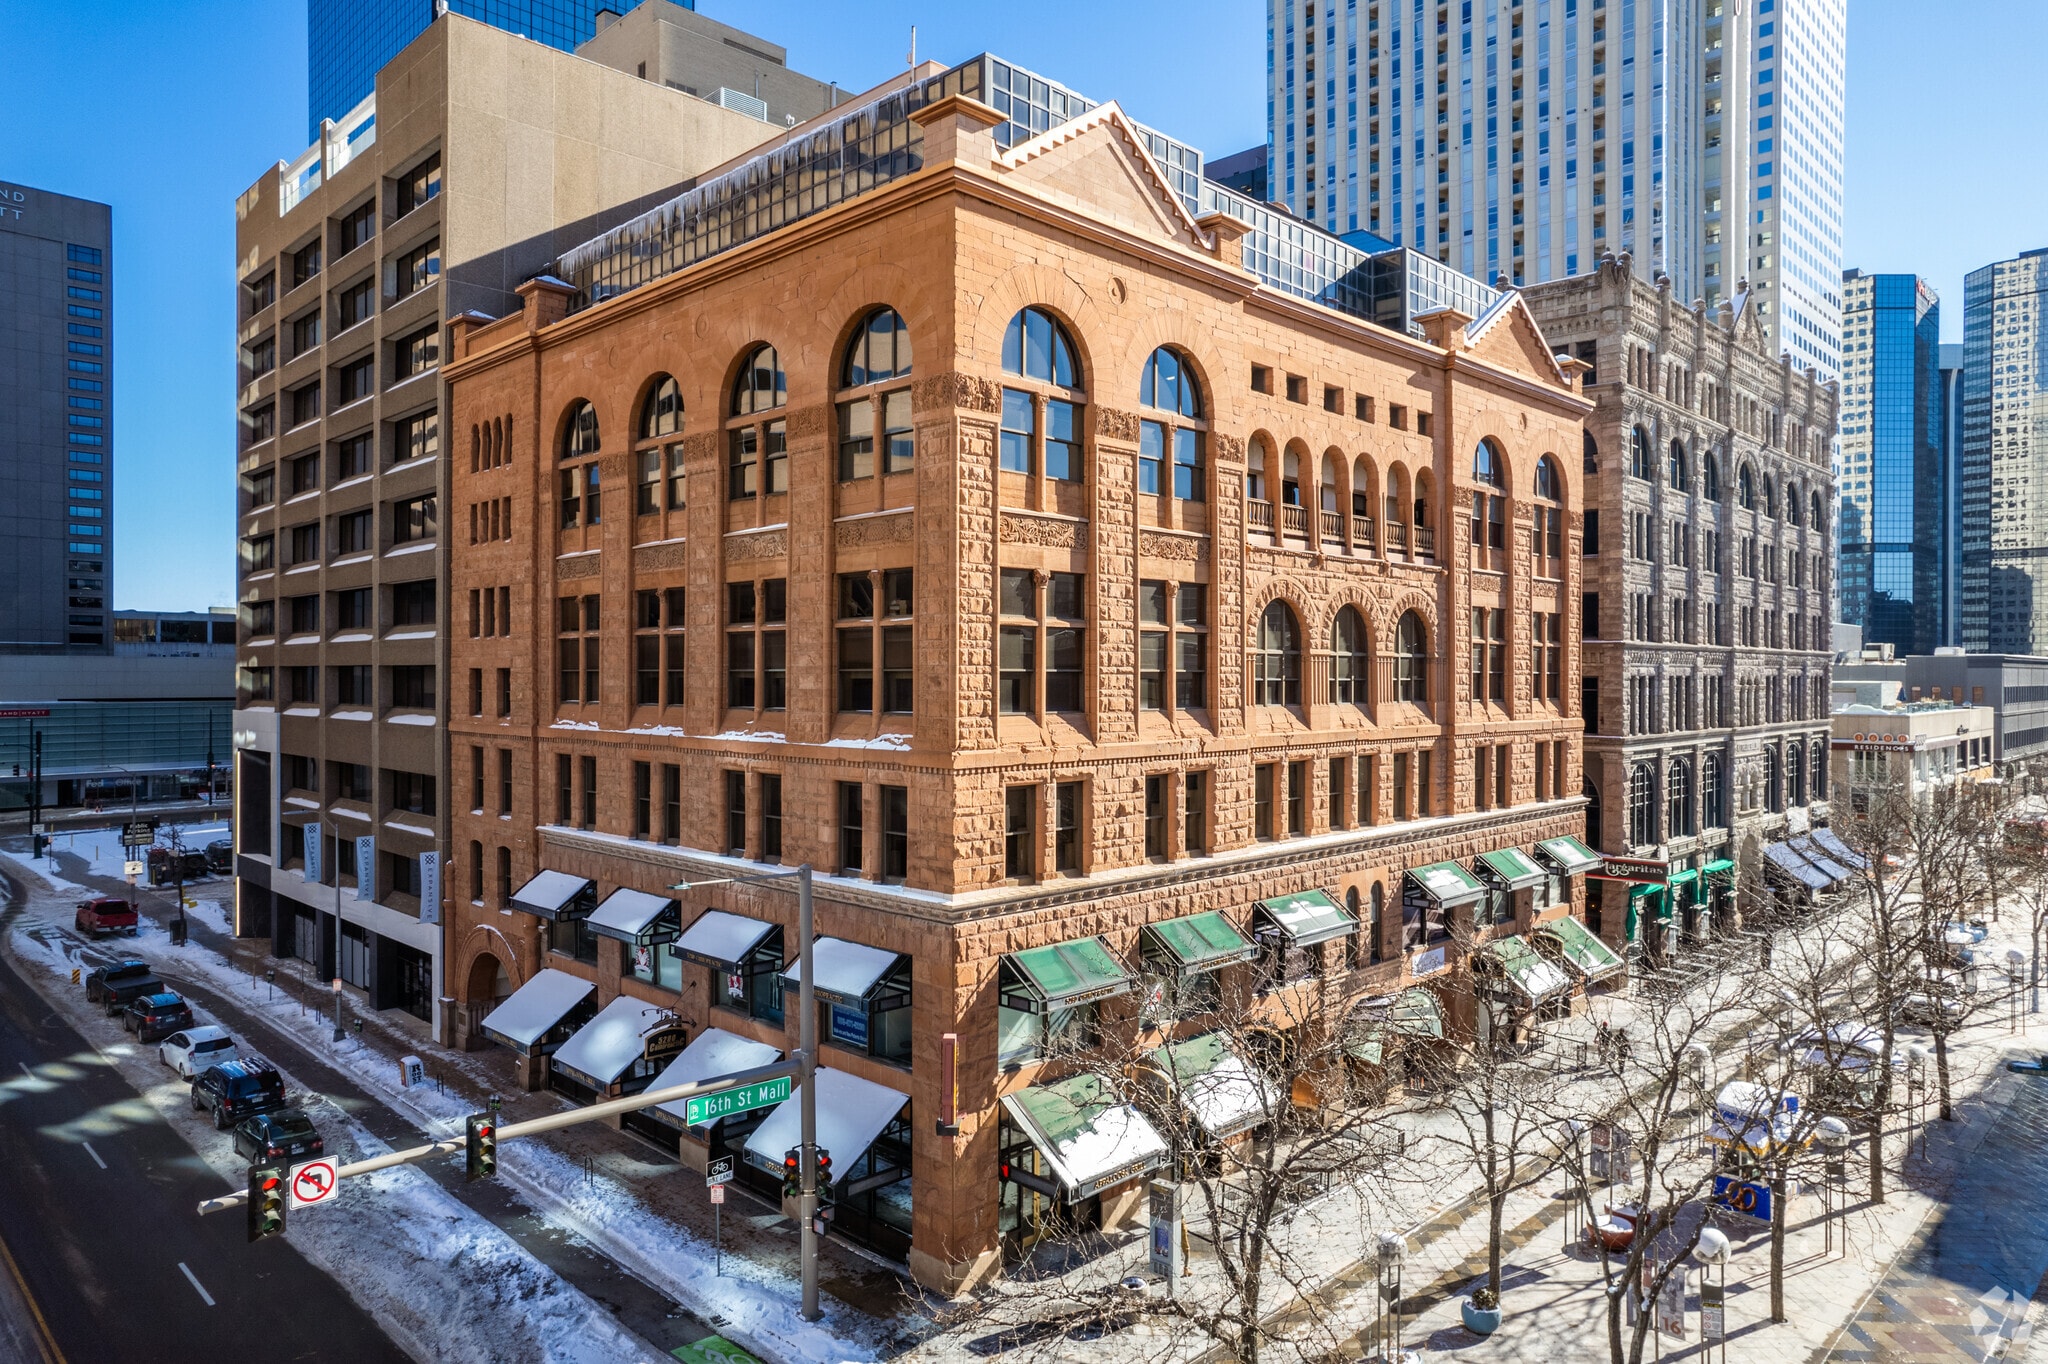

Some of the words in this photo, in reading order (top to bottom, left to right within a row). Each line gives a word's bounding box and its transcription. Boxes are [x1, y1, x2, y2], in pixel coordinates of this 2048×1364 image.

[704, 1096, 731, 1116] 16th
[737, 1091, 752, 1107] St
[759, 1082, 785, 1102] Mall
[720, 1170, 732, 1181] LANE
[1615, 1168, 1630, 1182] 16
[1662, 1316, 1682, 1336] 16
